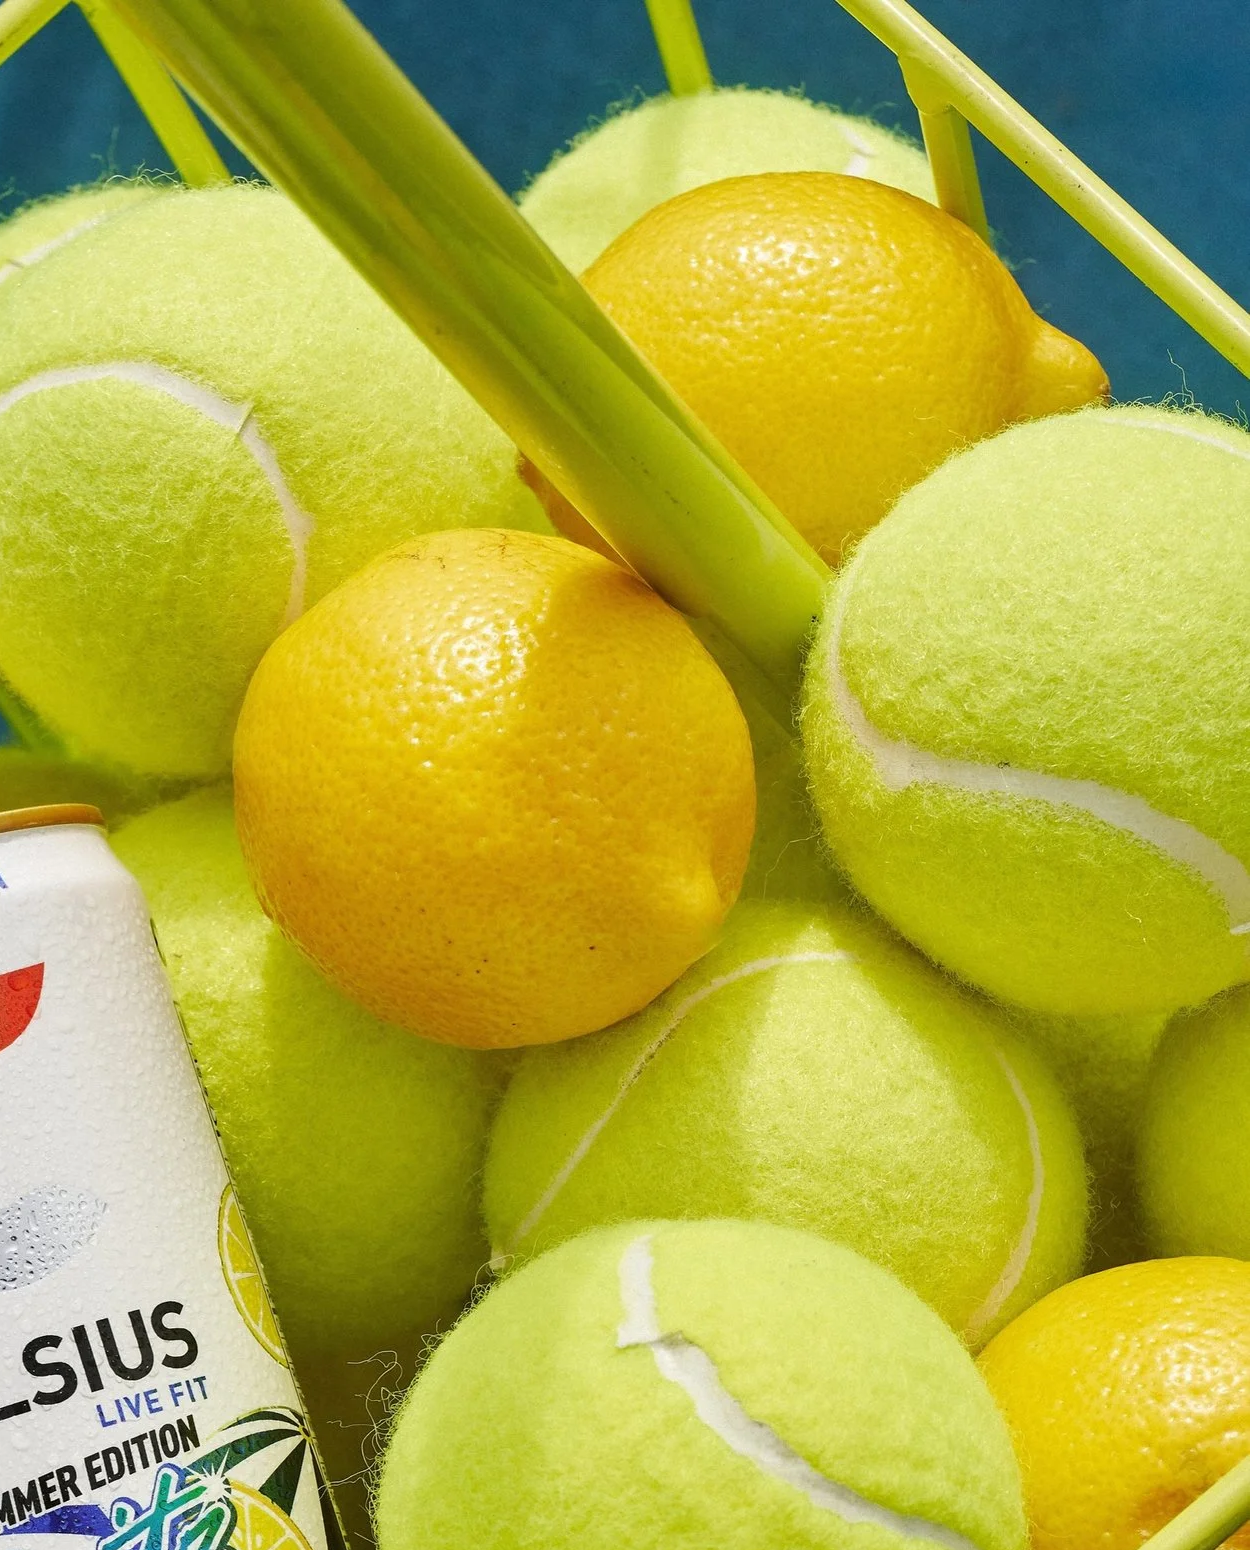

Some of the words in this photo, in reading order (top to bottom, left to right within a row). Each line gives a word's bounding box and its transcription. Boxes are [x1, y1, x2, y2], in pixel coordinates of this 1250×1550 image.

[96, 1388, 163, 1428] LIVE
[168, 1375, 209, 1407] FIT
[83, 1414, 201, 1491] EDITION
